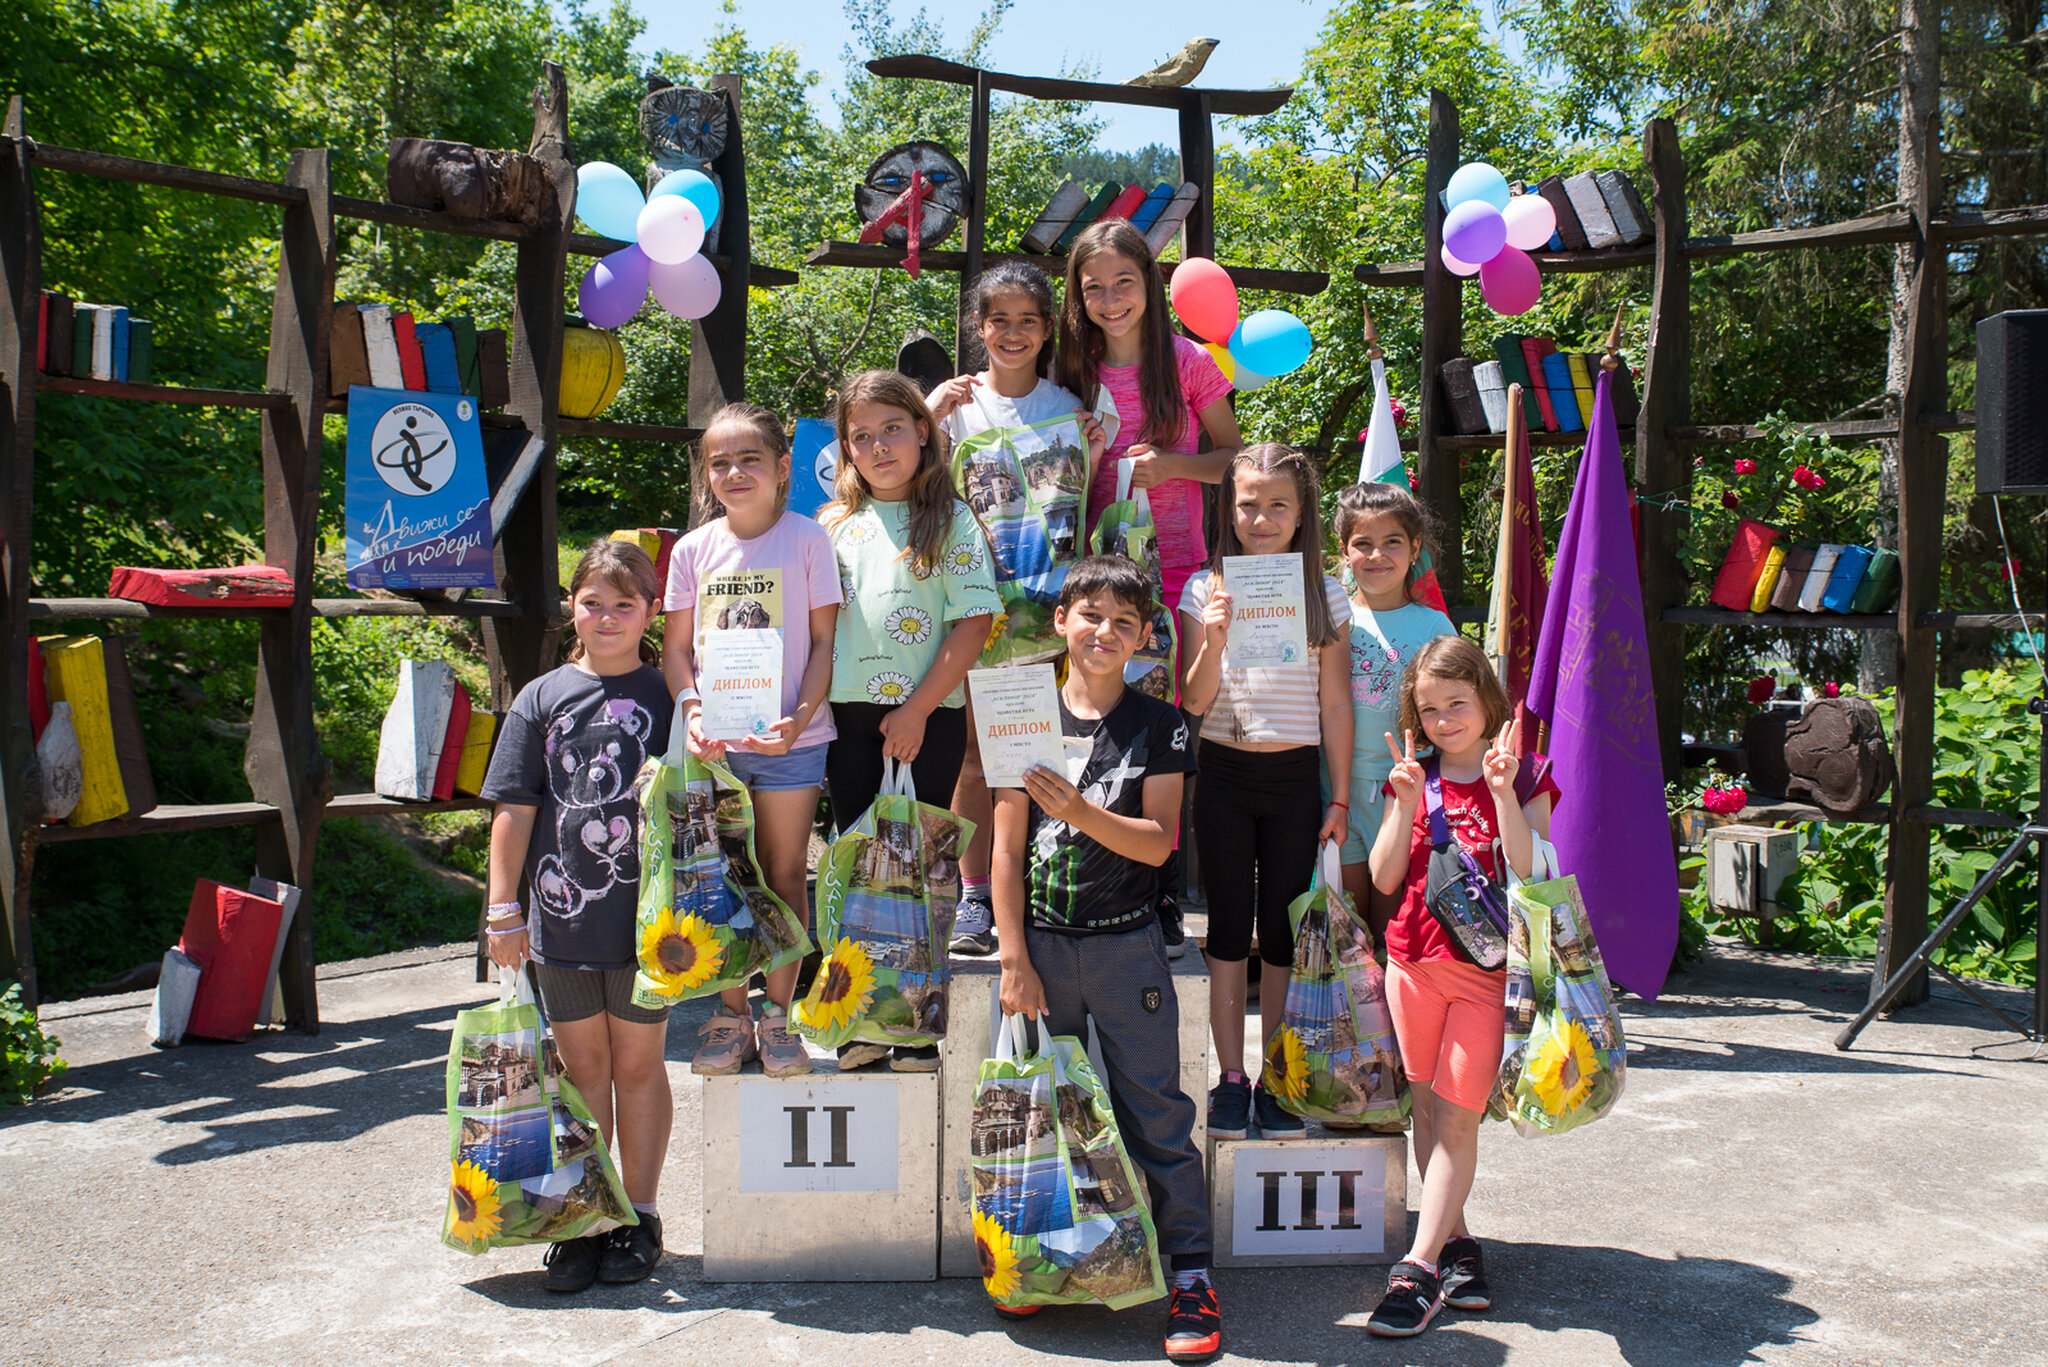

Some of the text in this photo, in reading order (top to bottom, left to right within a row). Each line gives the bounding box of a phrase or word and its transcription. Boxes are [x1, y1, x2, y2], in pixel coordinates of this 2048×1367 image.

[371, 499, 475, 546] Движи се
[383, 530, 481, 573] и победи
[707, 580, 775, 595] FRIEND?
[1236, 605, 1296, 621] ДИПЛОМ
[712, 677, 772, 692] ДИПЛОМ
[988, 721, 1051, 739] ДИПЛОМ
[1442, 803, 1468, 818] each
[783, 1106, 856, 1168] II
[1255, 1170, 1363, 1231] III
